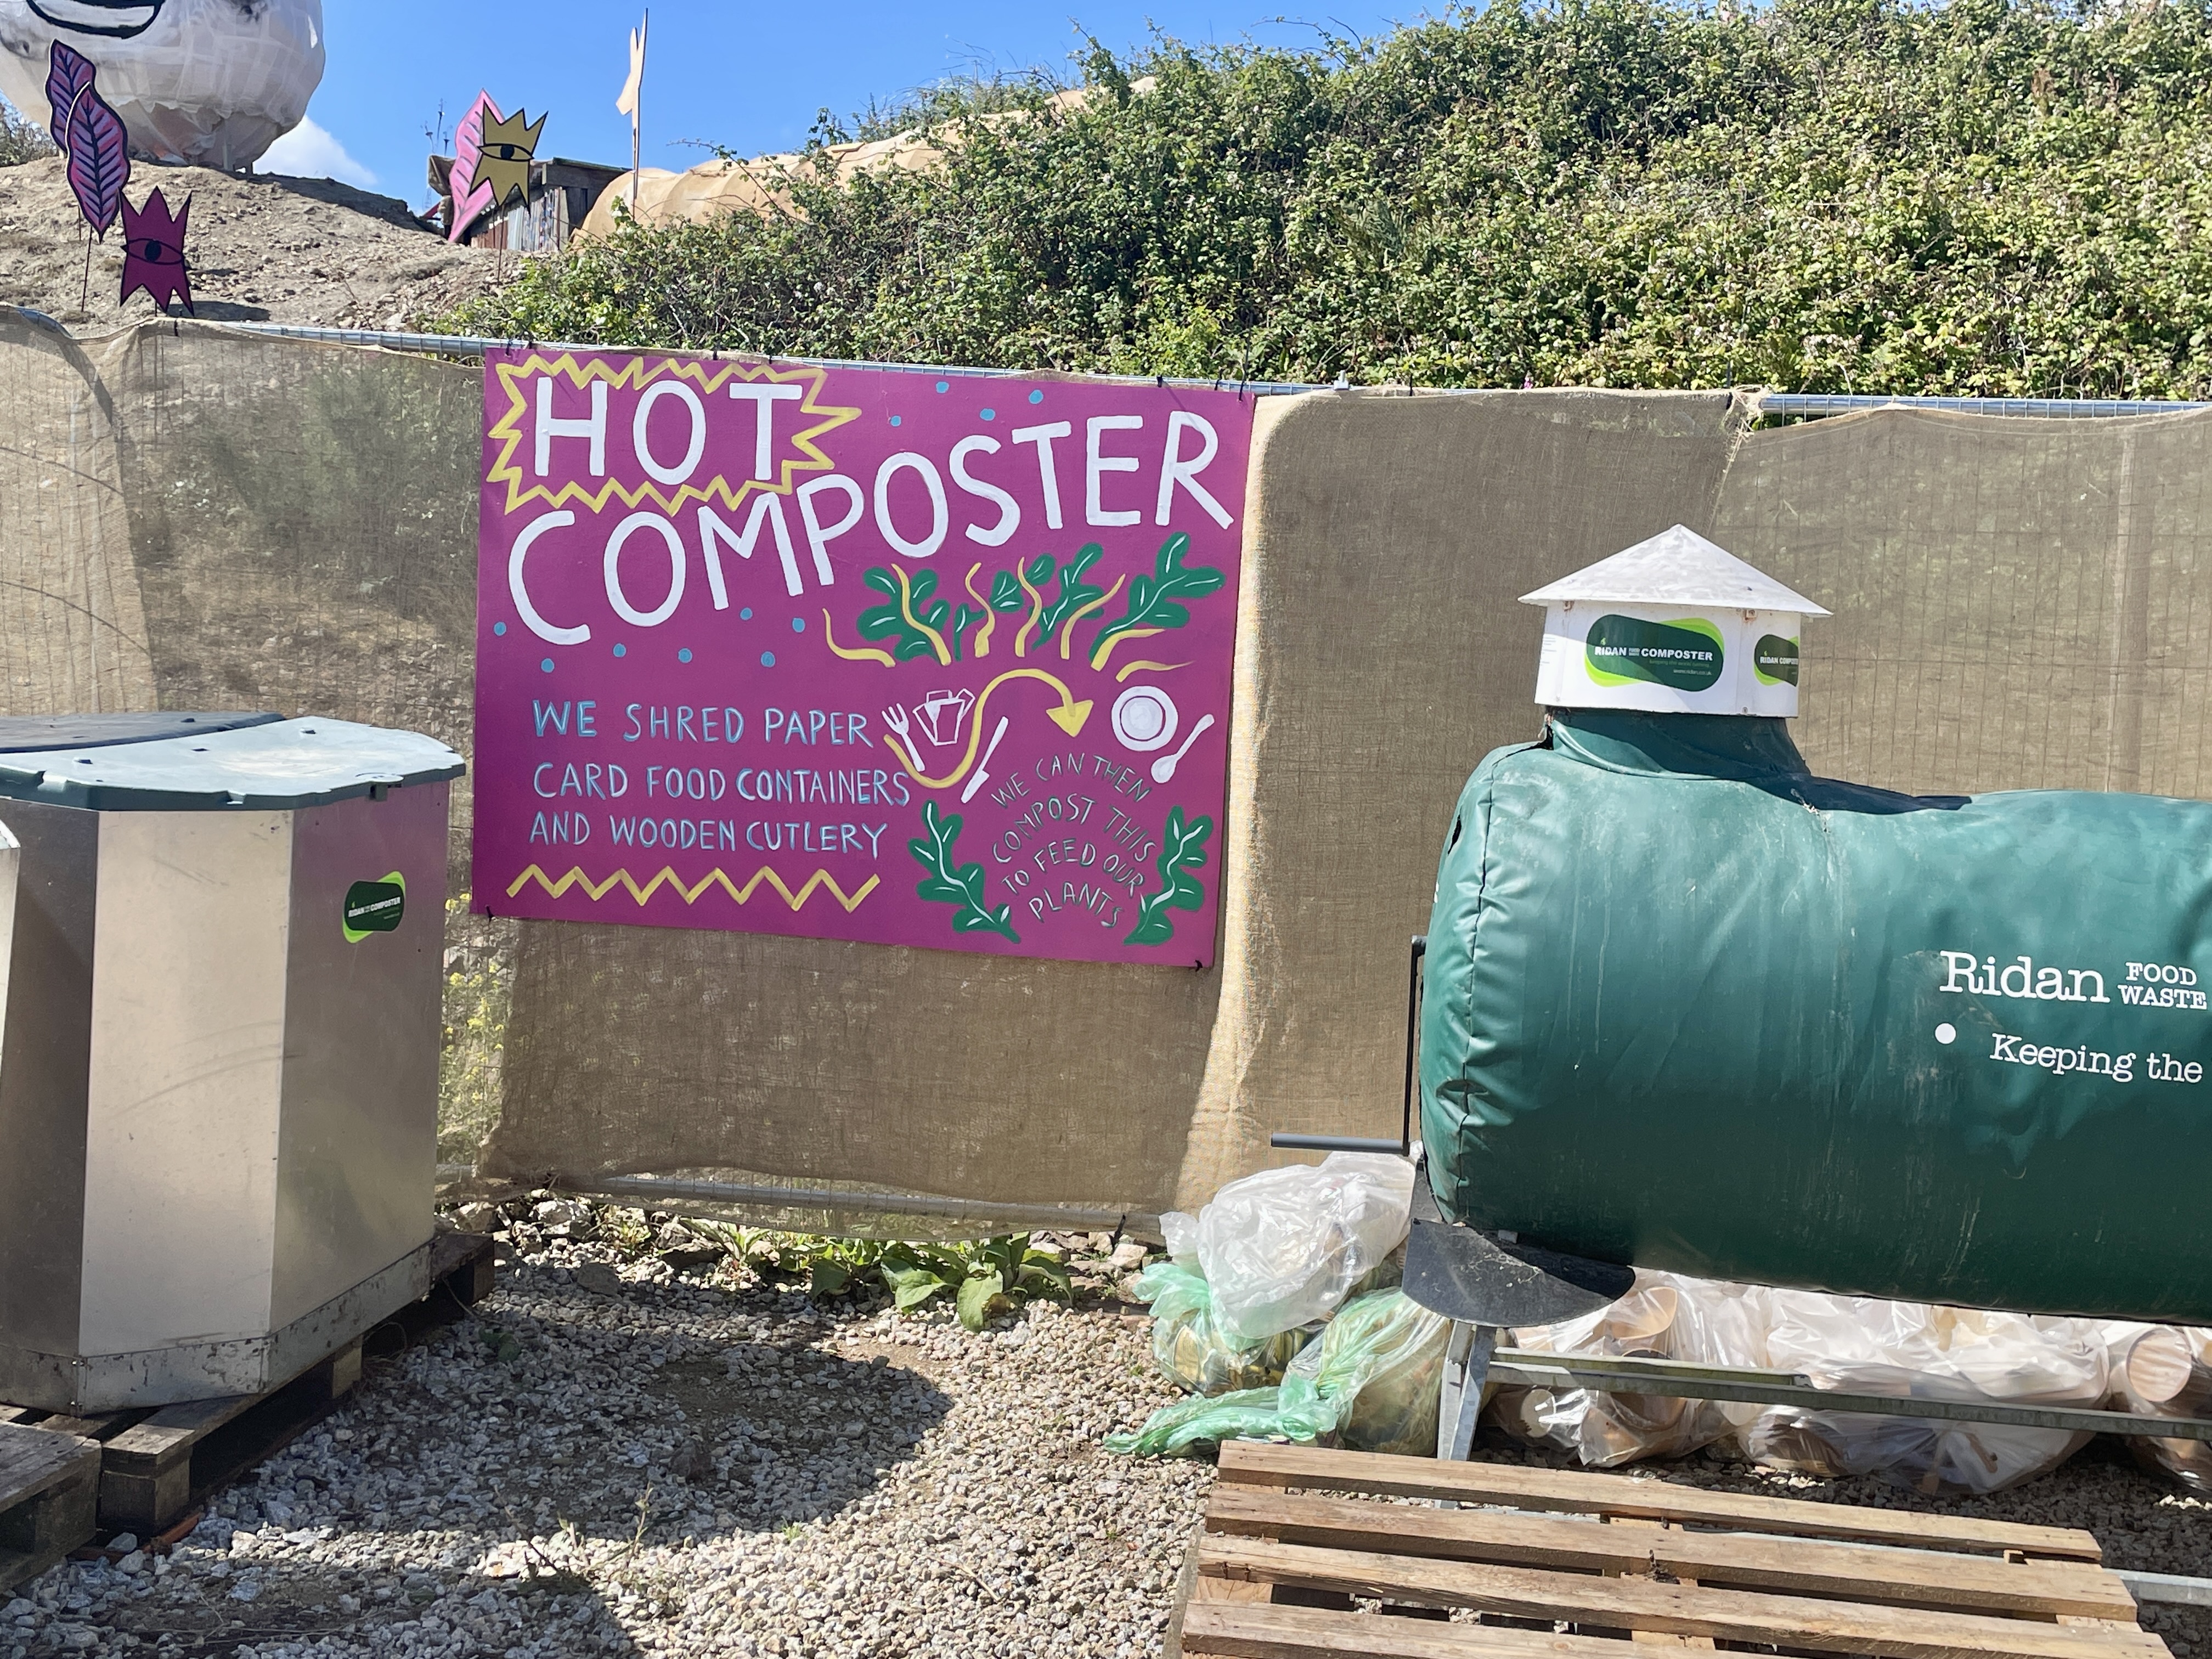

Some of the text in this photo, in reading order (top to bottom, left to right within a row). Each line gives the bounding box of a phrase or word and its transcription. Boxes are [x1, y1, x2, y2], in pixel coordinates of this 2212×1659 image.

[535, 377, 803, 485] HOT
[509, 410, 1234, 645] COMPOSTER
[1594, 646, 1627, 656] RIDAN
[1641, 648, 1713, 661] COMPOSTER
[532, 699, 873, 748] WE SHRED PAPER
[533, 763, 910, 806] CARD FOOD CONTAINERS
[991, 752, 1152, 808] WE CAN THEN
[529, 811, 888, 860] AND WOODEN CUTLERY
[992, 793, 1157, 863] COMPOST THIS
[1001, 838, 1145, 898] TO FEED OUR
[1028, 881, 1124, 928] PLANTS
[1939, 950, 2111, 1003] Ridan
[2117, 984, 2207, 1009] WASTE
[2125, 962, 2197, 985] FOOD
[1989, 1032, 2203, 1083] Keeping the
